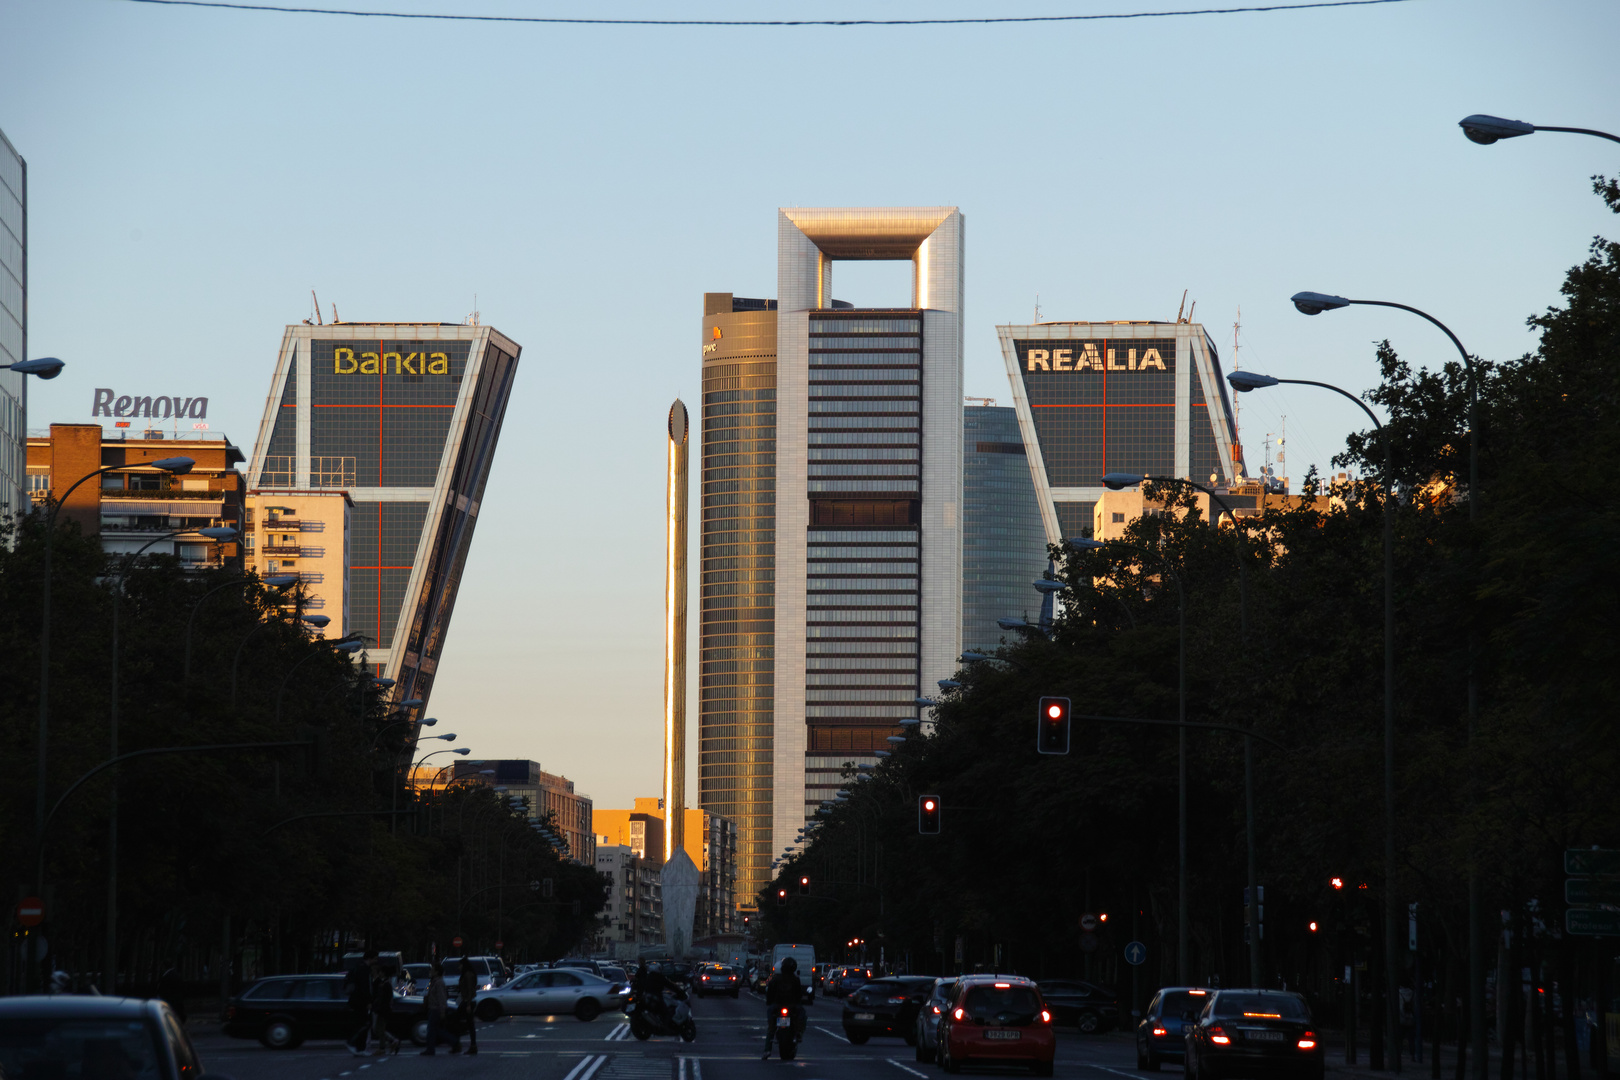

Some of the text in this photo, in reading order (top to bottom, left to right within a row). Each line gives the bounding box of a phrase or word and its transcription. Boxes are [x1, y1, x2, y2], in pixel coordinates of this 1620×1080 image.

[334, 347, 448, 374] Bankia
[703, 343, 717, 356] pwc
[1027, 343, 1167, 371] REALIA
[91, 388, 209, 419] Renova
[1571, 920, 1613, 930] Profesor
